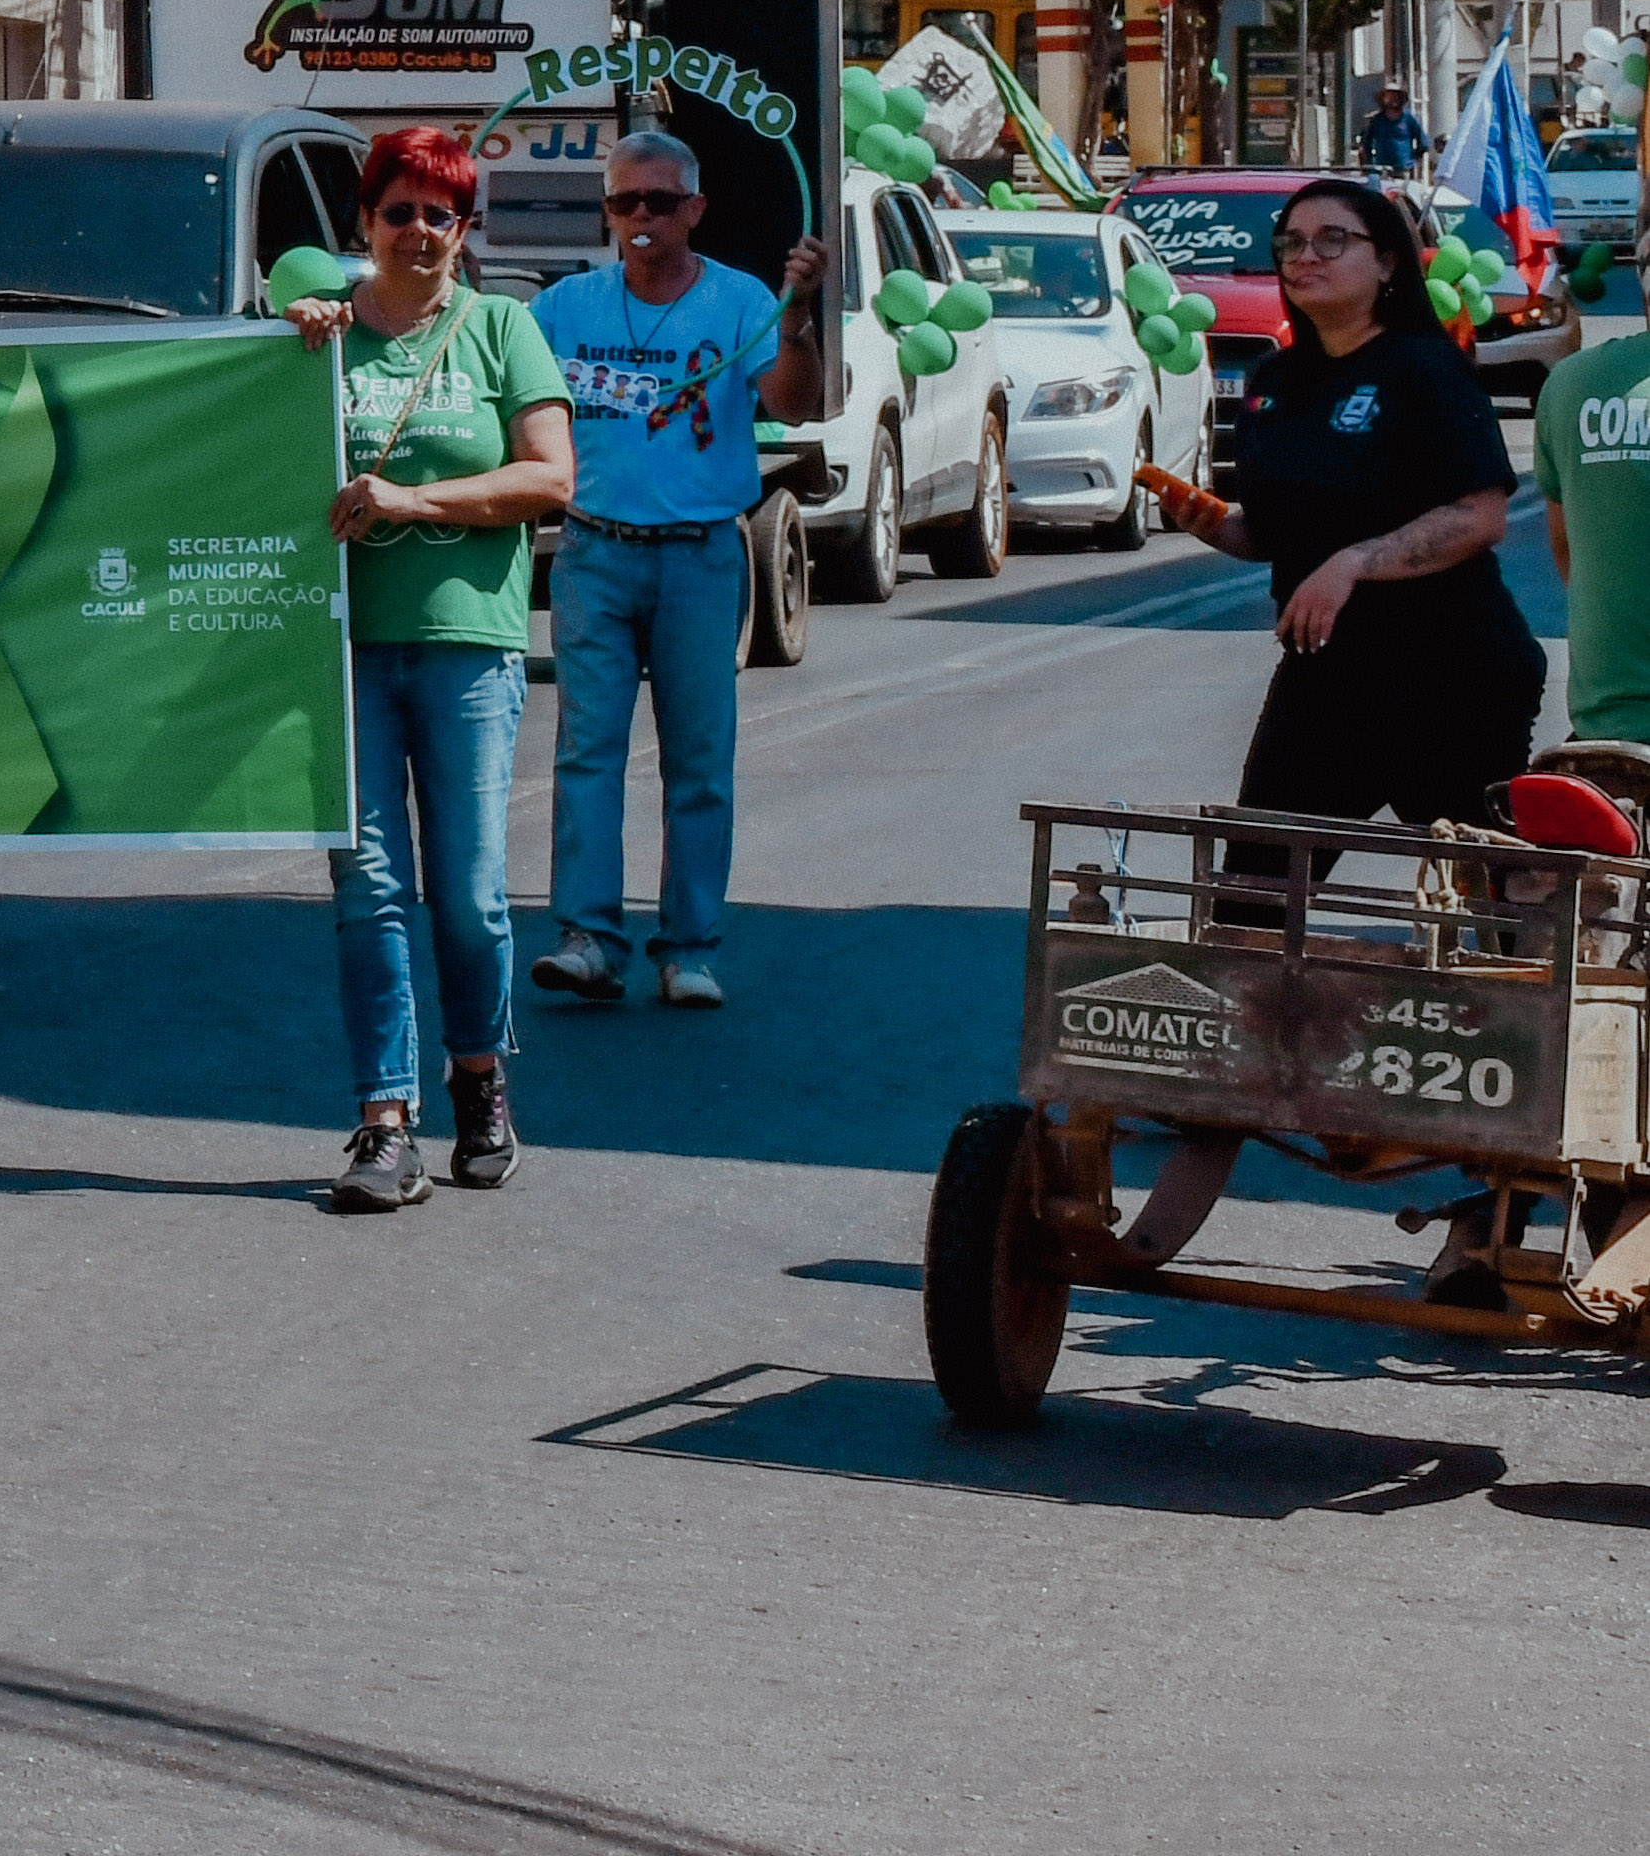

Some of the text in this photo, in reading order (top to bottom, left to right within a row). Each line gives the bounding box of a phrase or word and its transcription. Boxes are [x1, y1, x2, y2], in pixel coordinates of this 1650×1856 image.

[289, 25, 529, 47] INSTALAÇÃO DE SOM AUTOMOTIVO
[526, 37, 796, 138] Respeito
[1148, 218, 1174, 233] A
[575, 343, 677, 365] Autismo
[168, 536, 298, 556] SECRETARIA
[168, 562, 286, 581] MUNICIPAL
[169, 583, 326, 609] DA EDUCAÇÃO
[81, 598, 146, 617] CACULÉ
[169, 613, 285, 632] E CULTURA
[1133, 1046, 1151, 1058] DE
